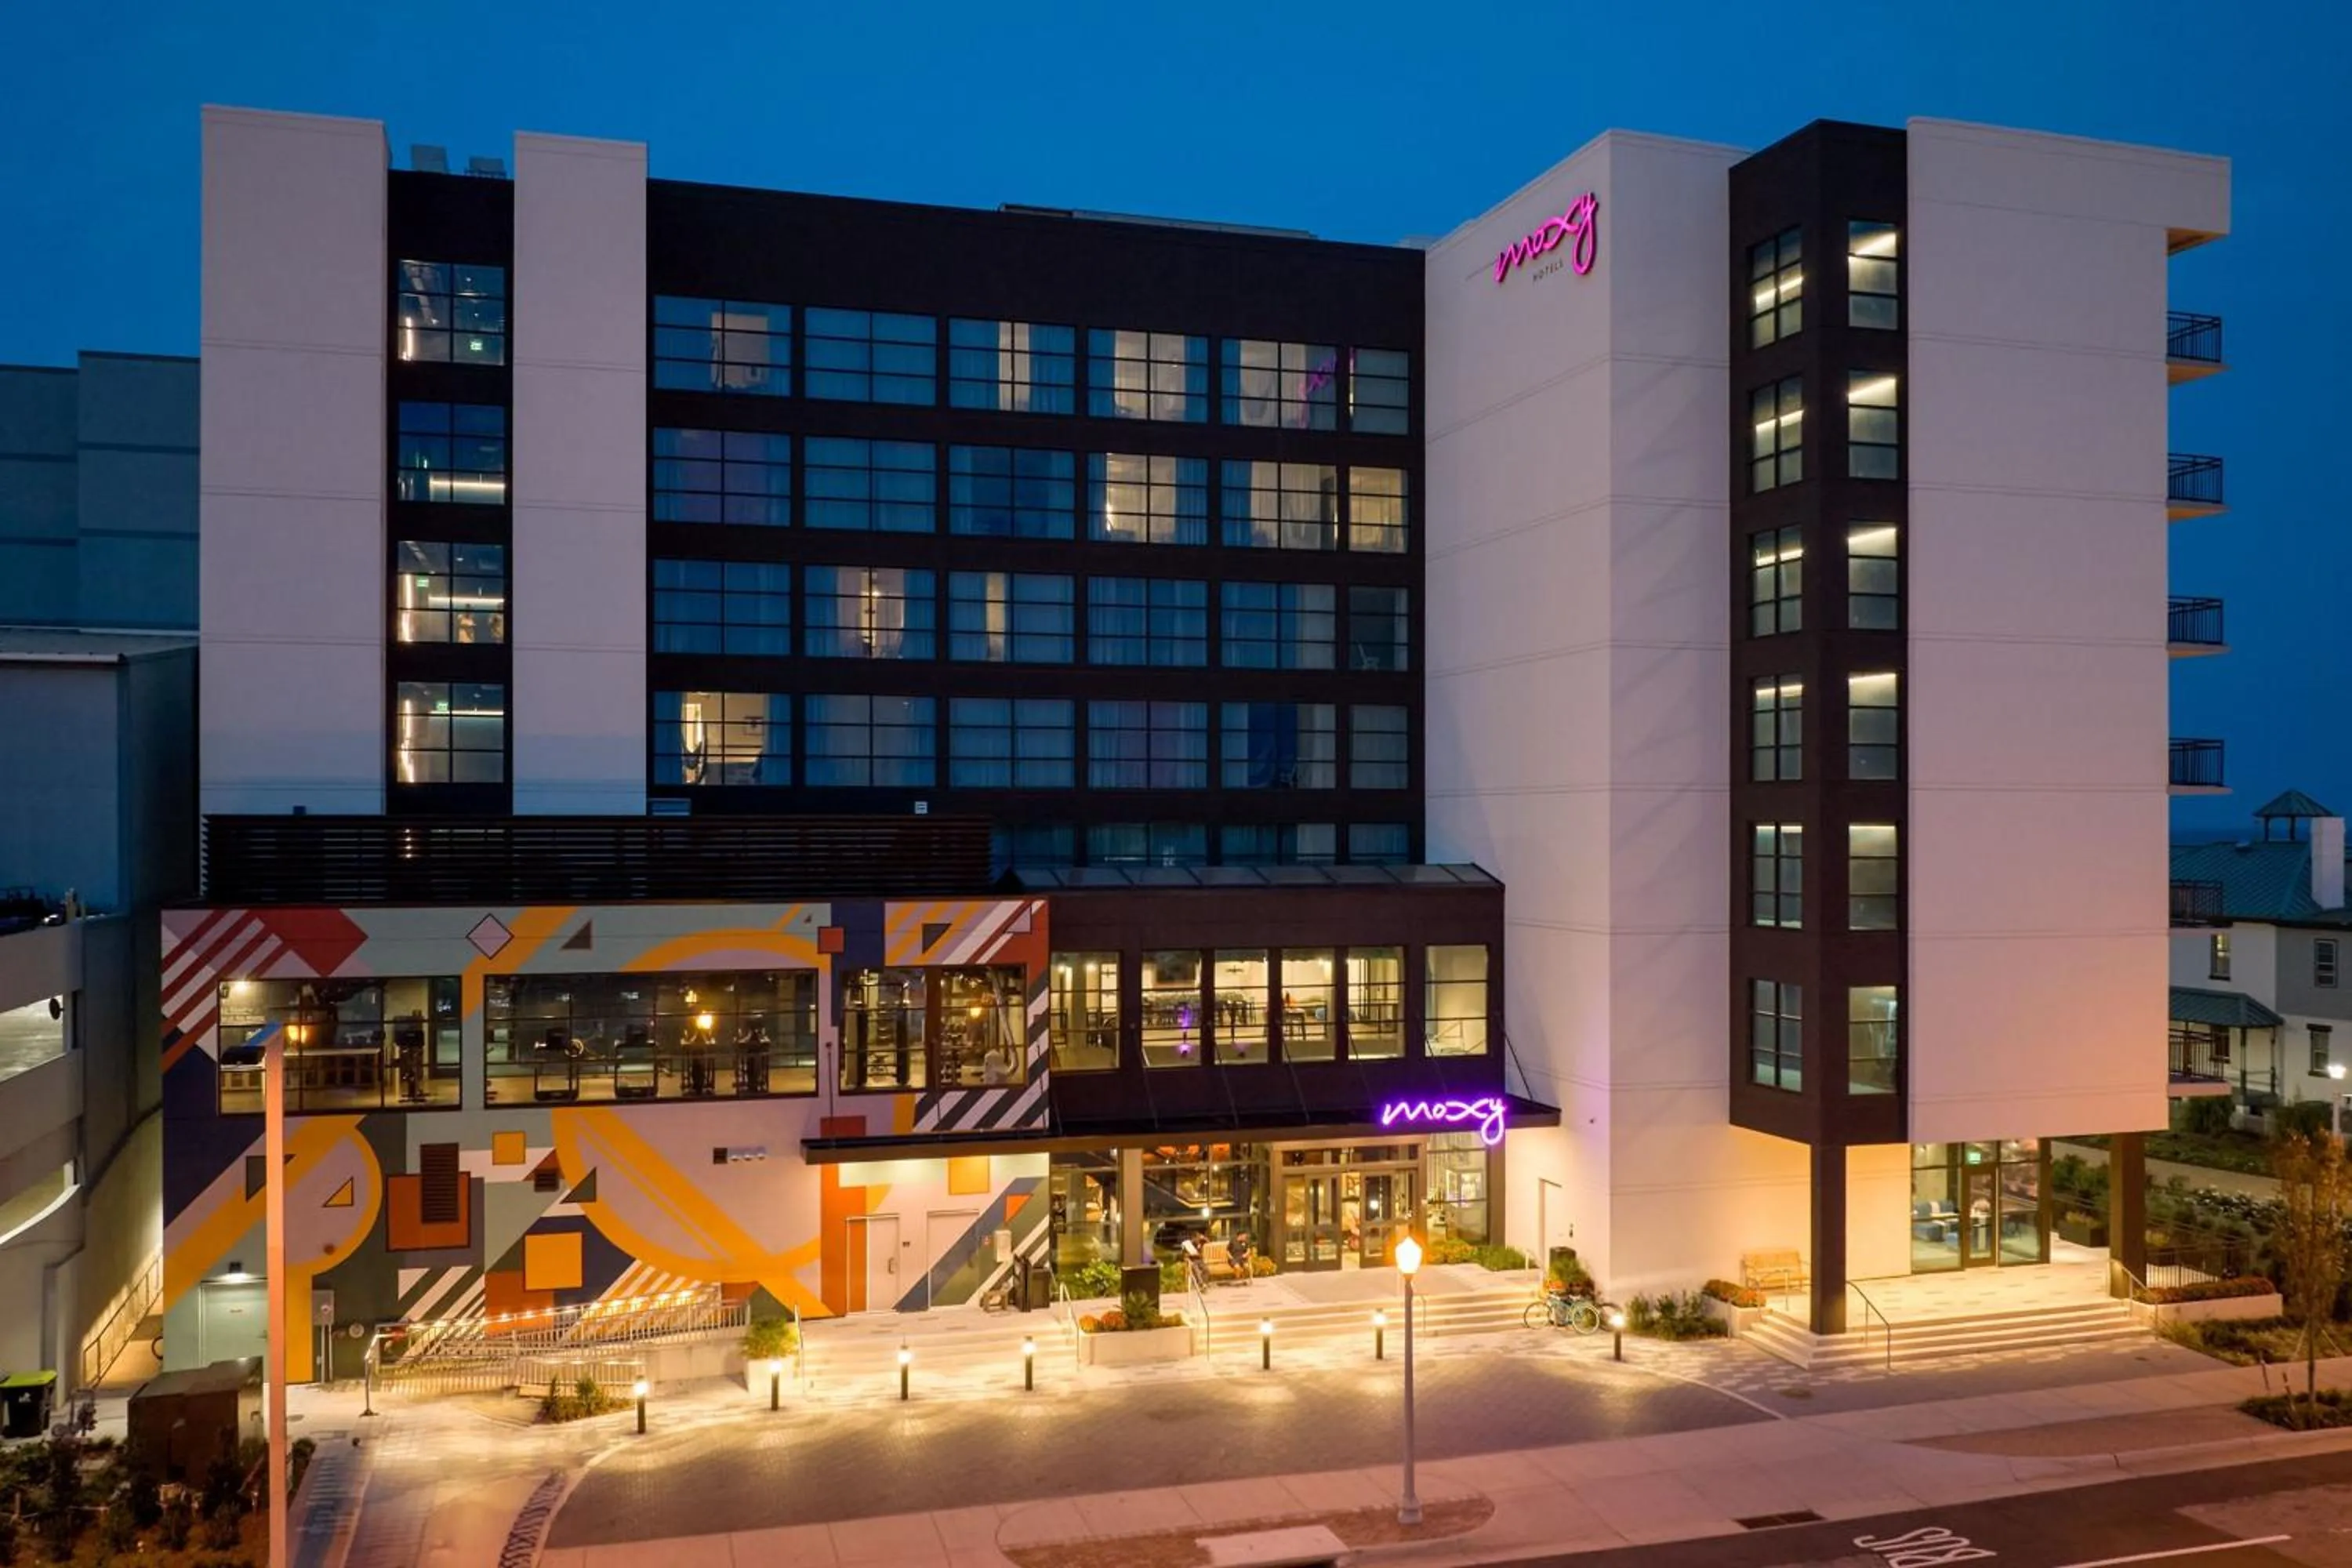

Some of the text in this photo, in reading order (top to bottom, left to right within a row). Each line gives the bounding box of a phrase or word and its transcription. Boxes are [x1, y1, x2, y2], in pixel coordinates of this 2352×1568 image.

[1494, 192, 1599, 283] moxy
[1382, 1098, 1505, 1145] moxy
[1853, 1526, 1998, 1568] BUS
